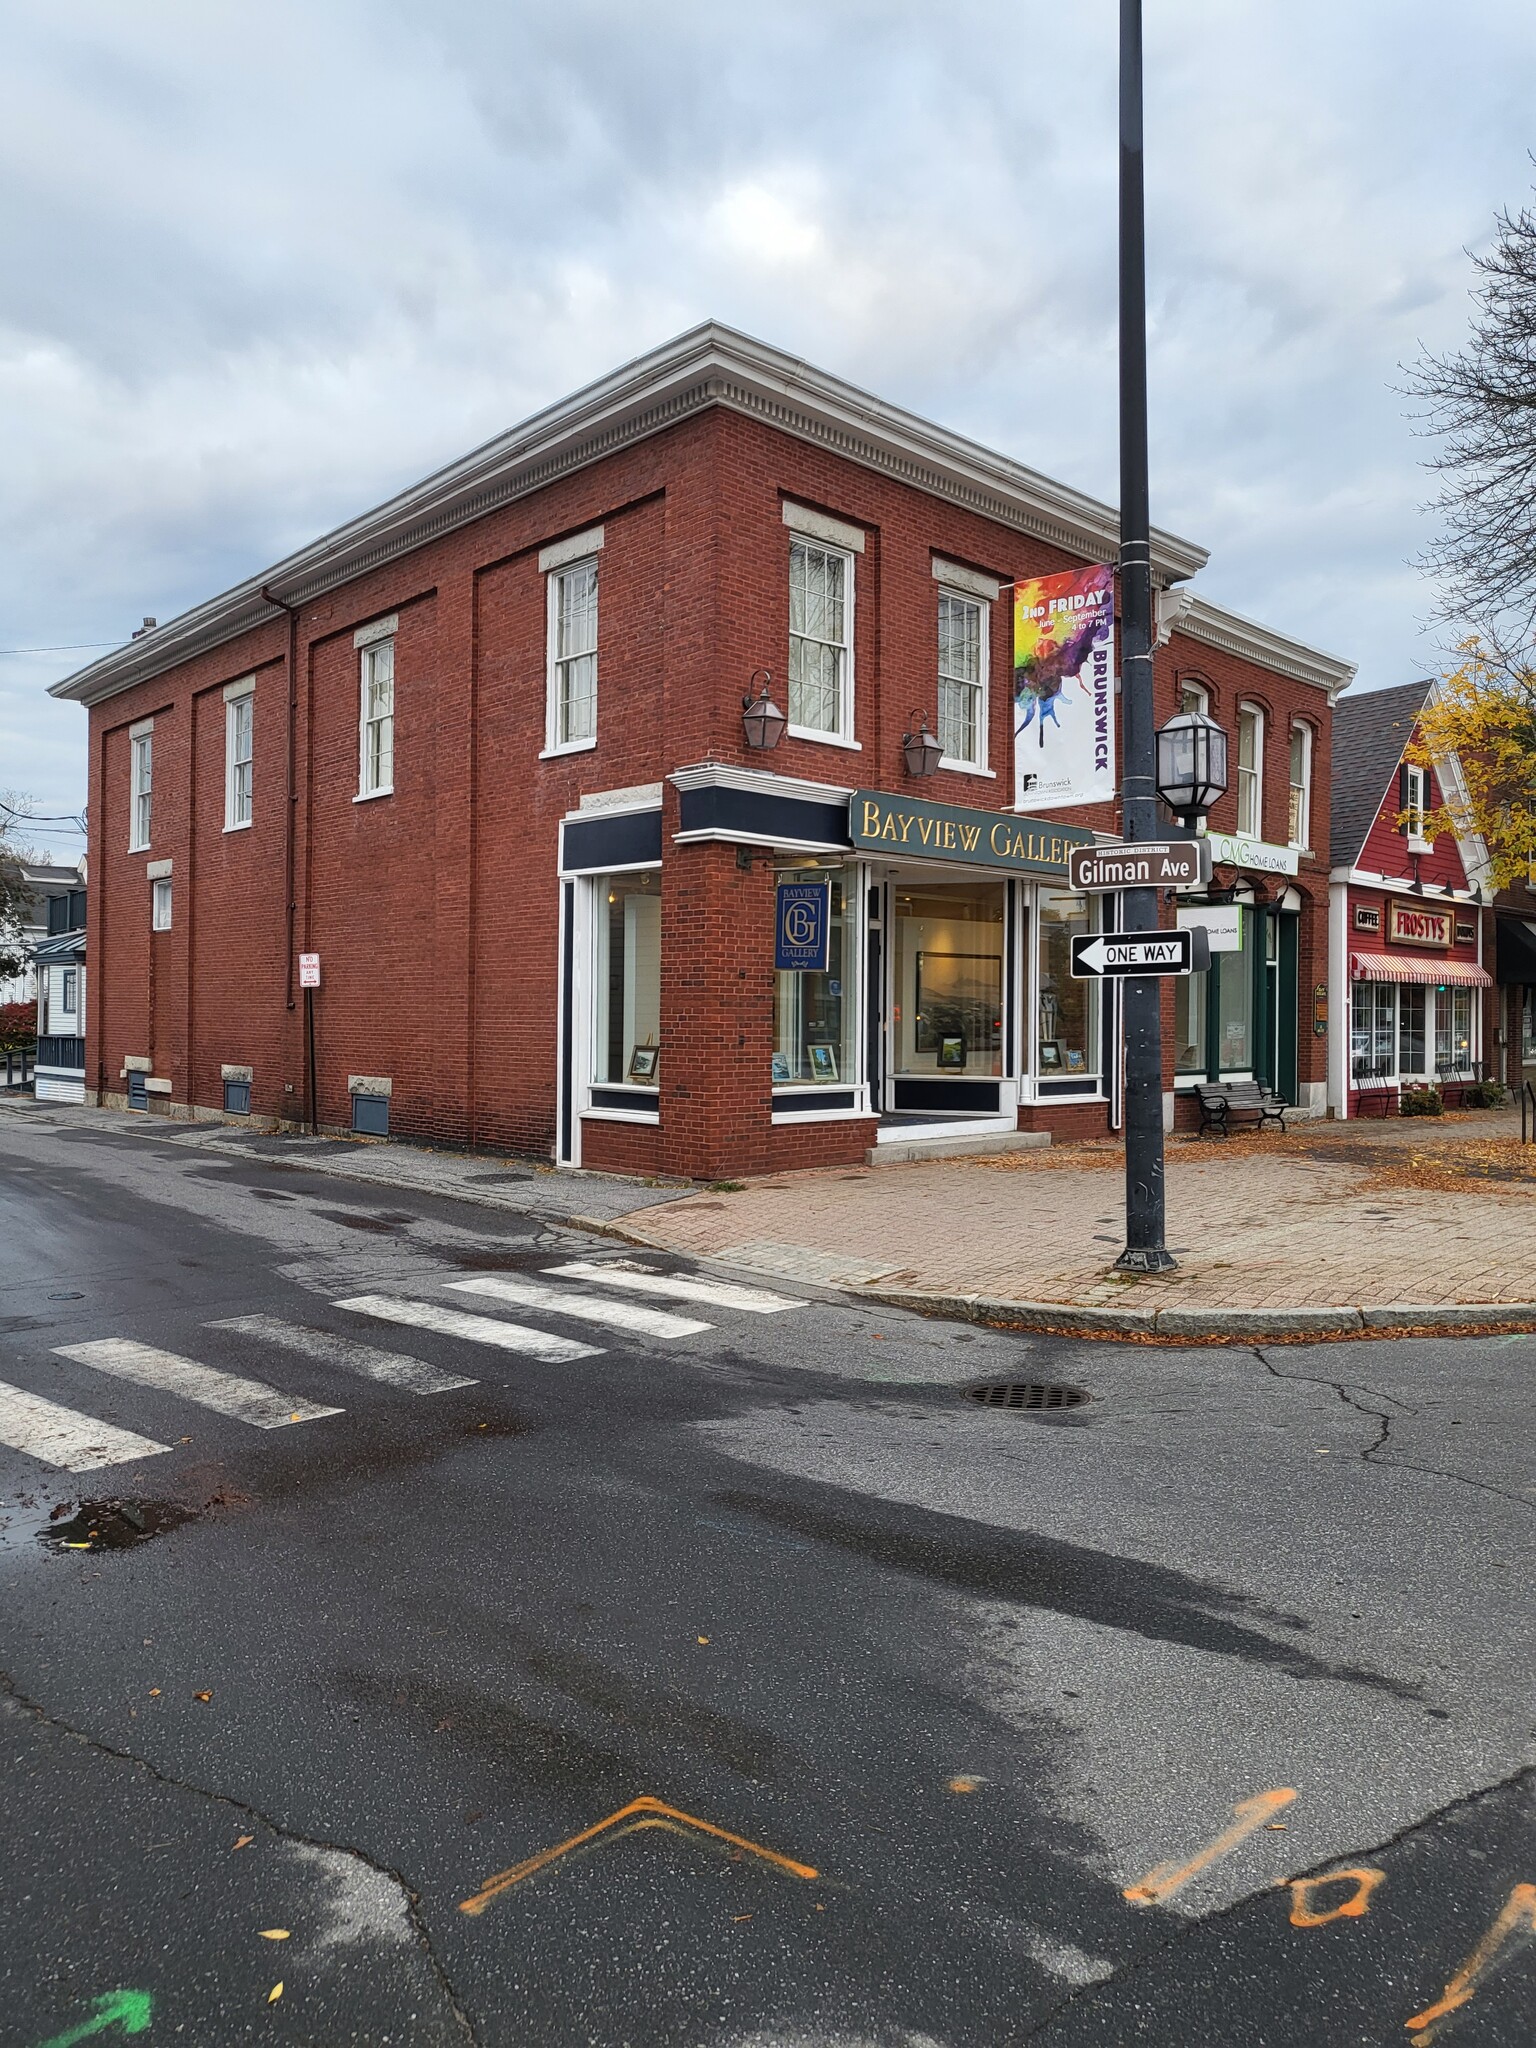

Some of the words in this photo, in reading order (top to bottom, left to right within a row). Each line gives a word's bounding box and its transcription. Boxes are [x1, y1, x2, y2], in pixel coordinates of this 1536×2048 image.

[1022, 605, 1045, 620] 2ND
[1049, 589, 1106, 614] FRIDAY
[1037, 619, 1055, 629] June
[1063, 609, 1107, 624] September
[1078, 622, 1086, 630] to
[1088, 620, 1093, 628] 7
[1096, 618, 1107, 626] PM
[1093, 649, 1108, 772] BRUNSWICK
[1038, 777, 1072, 788] Brunswick
[861, 800, 982, 851] BAYVIEW
[1098, 848, 1131, 856] HISTORIC
[1220, 838, 1250, 864] CMG
[1250, 854, 1268, 868] HOME
[1268, 858, 1287, 870] LOANS
[1079, 859, 1150, 884] Gilman
[1160, 858, 1190, 878] Ave
[783, 888, 821, 898] BAYVIEW
[782, 948, 820, 958] GALLERY
[1106, 946, 1138, 963] ONE
[1144, 944, 1177, 961] WAY
